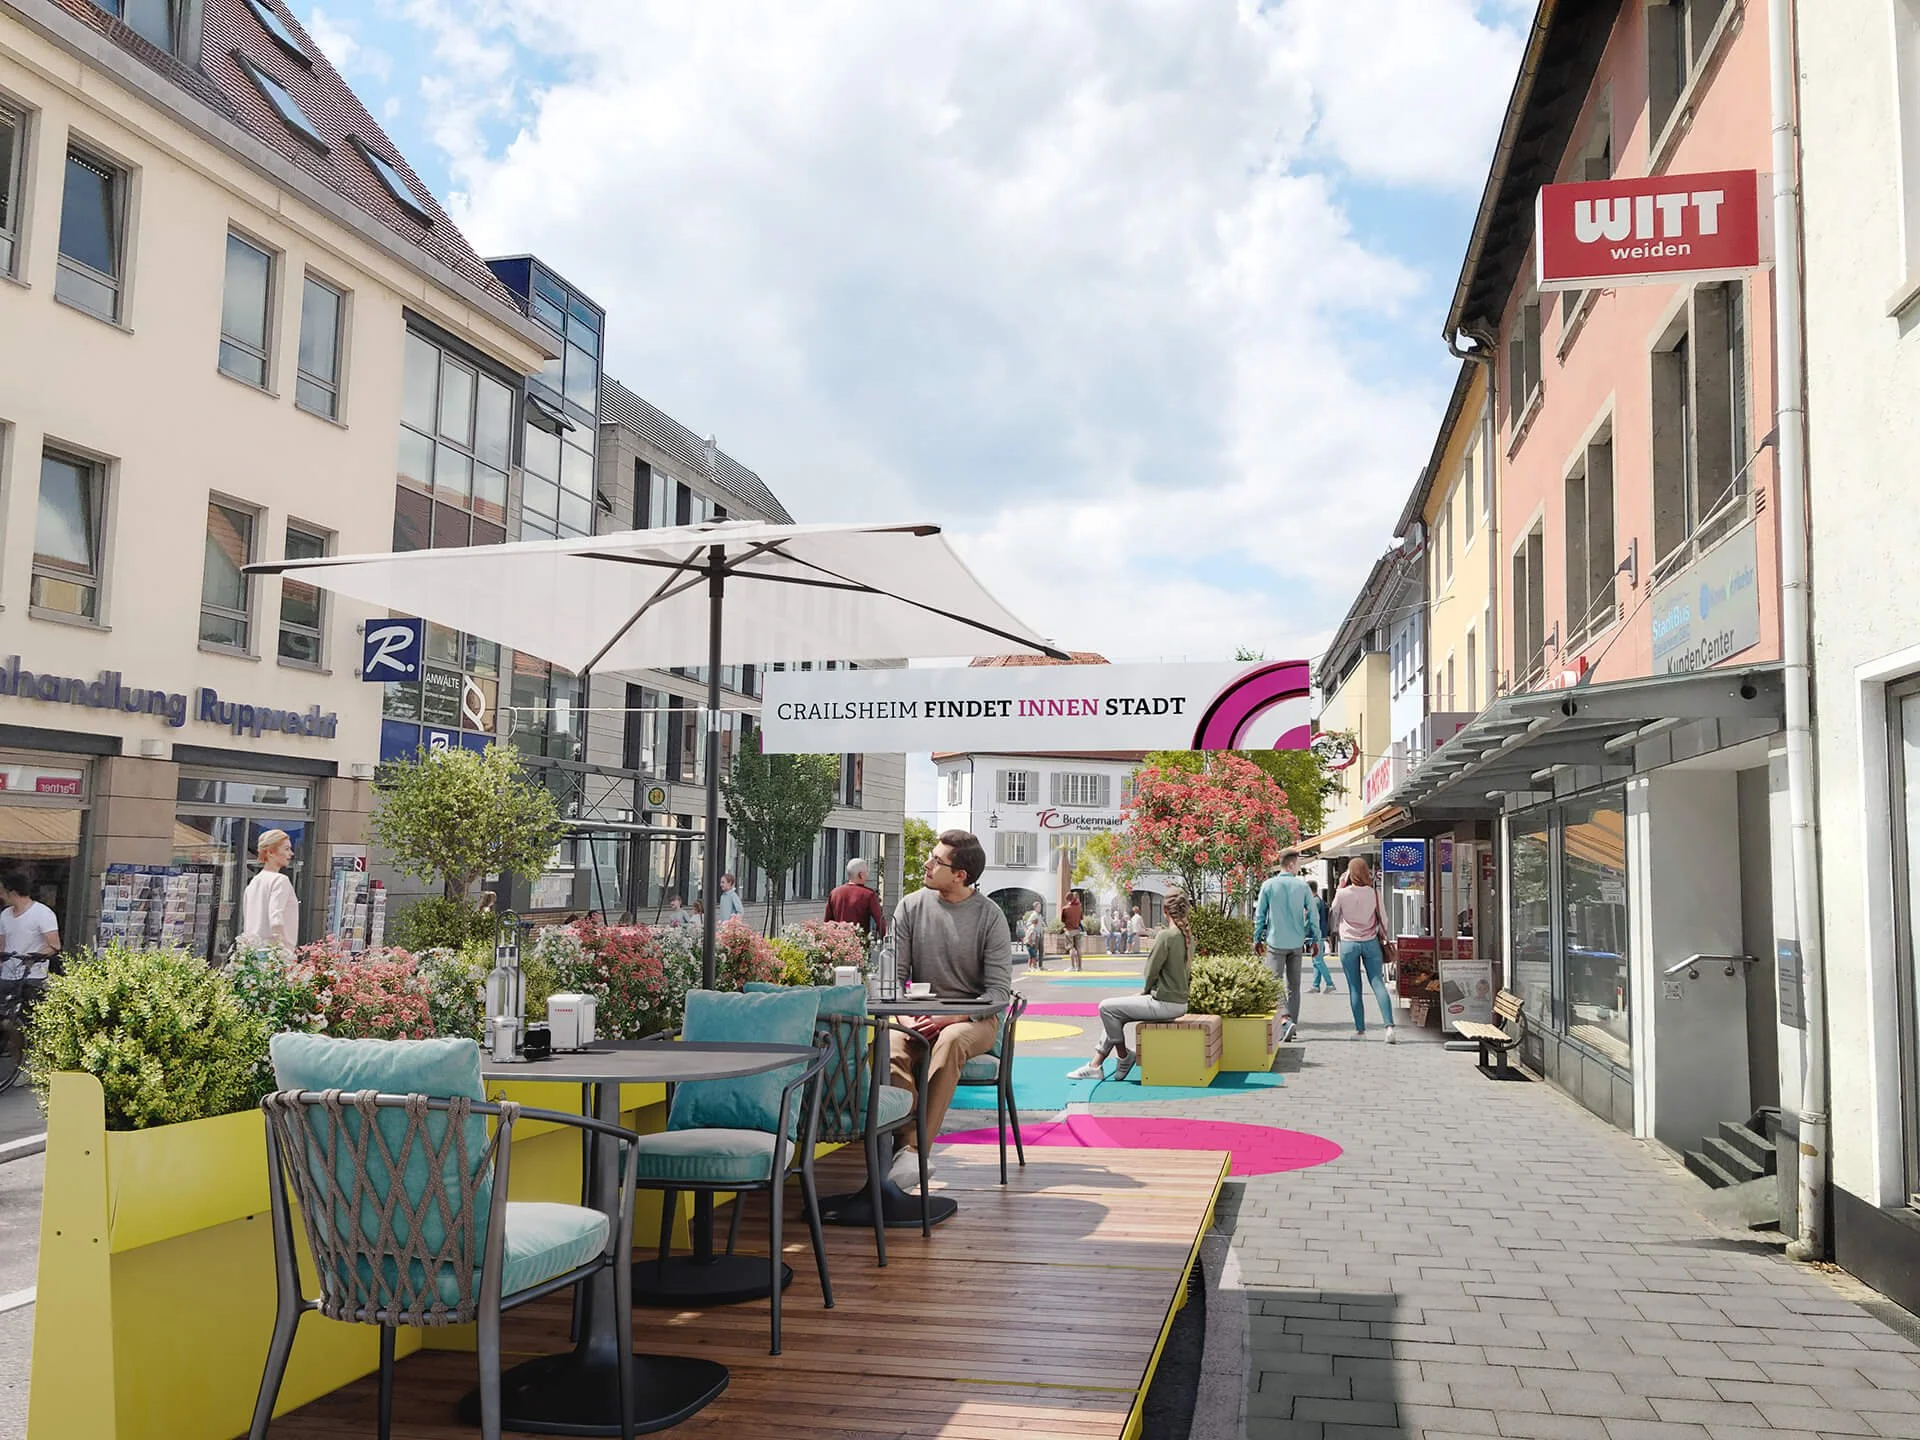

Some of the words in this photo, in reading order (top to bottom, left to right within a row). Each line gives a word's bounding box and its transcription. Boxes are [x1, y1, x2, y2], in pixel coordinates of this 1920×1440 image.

[1575, 189, 1725, 244] WITT
[1611, 241, 1692, 260] weiden
[1652, 604, 1691, 642] StadtBus
[1667, 628, 1735, 675] KundenCenter
[0, 654, 187, 728] handlung
[195, 686, 339, 739] Rupprecht
[777, 701, 918, 720] CRAILSHEIM
[924, 699, 1013, 718] FINDET
[1017, 698, 1100, 717] INNEN
[1105, 697, 1186, 716] STADT
[1063, 813, 1123, 826] Buckenmaier
